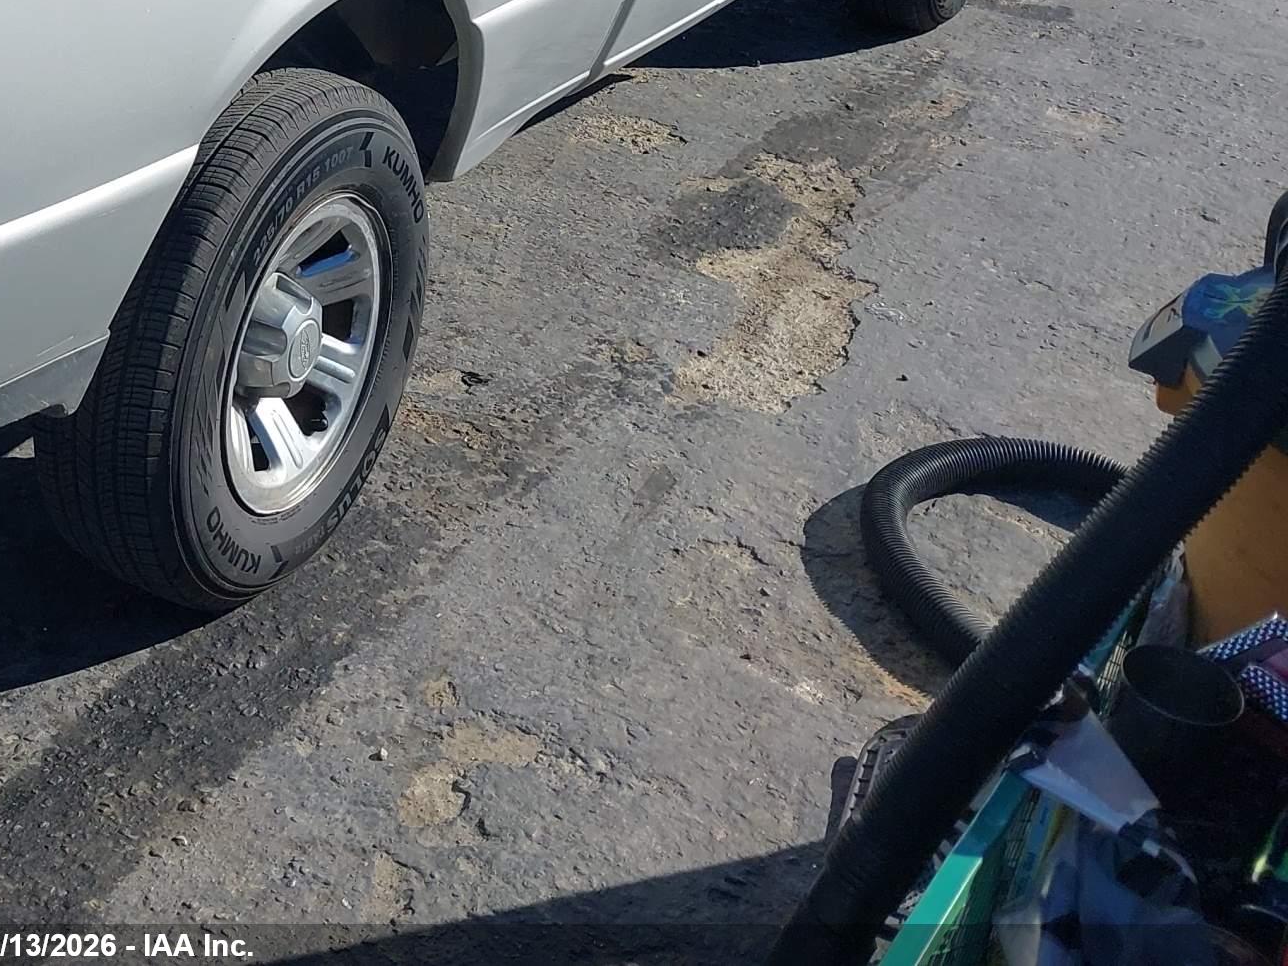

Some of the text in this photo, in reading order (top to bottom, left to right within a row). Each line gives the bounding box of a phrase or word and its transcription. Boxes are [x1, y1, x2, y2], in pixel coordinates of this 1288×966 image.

[382, 146, 424, 223] KUMHO
[321, 428, 387, 535] SOLUS
[207, 506, 262, 574] KUMHO
